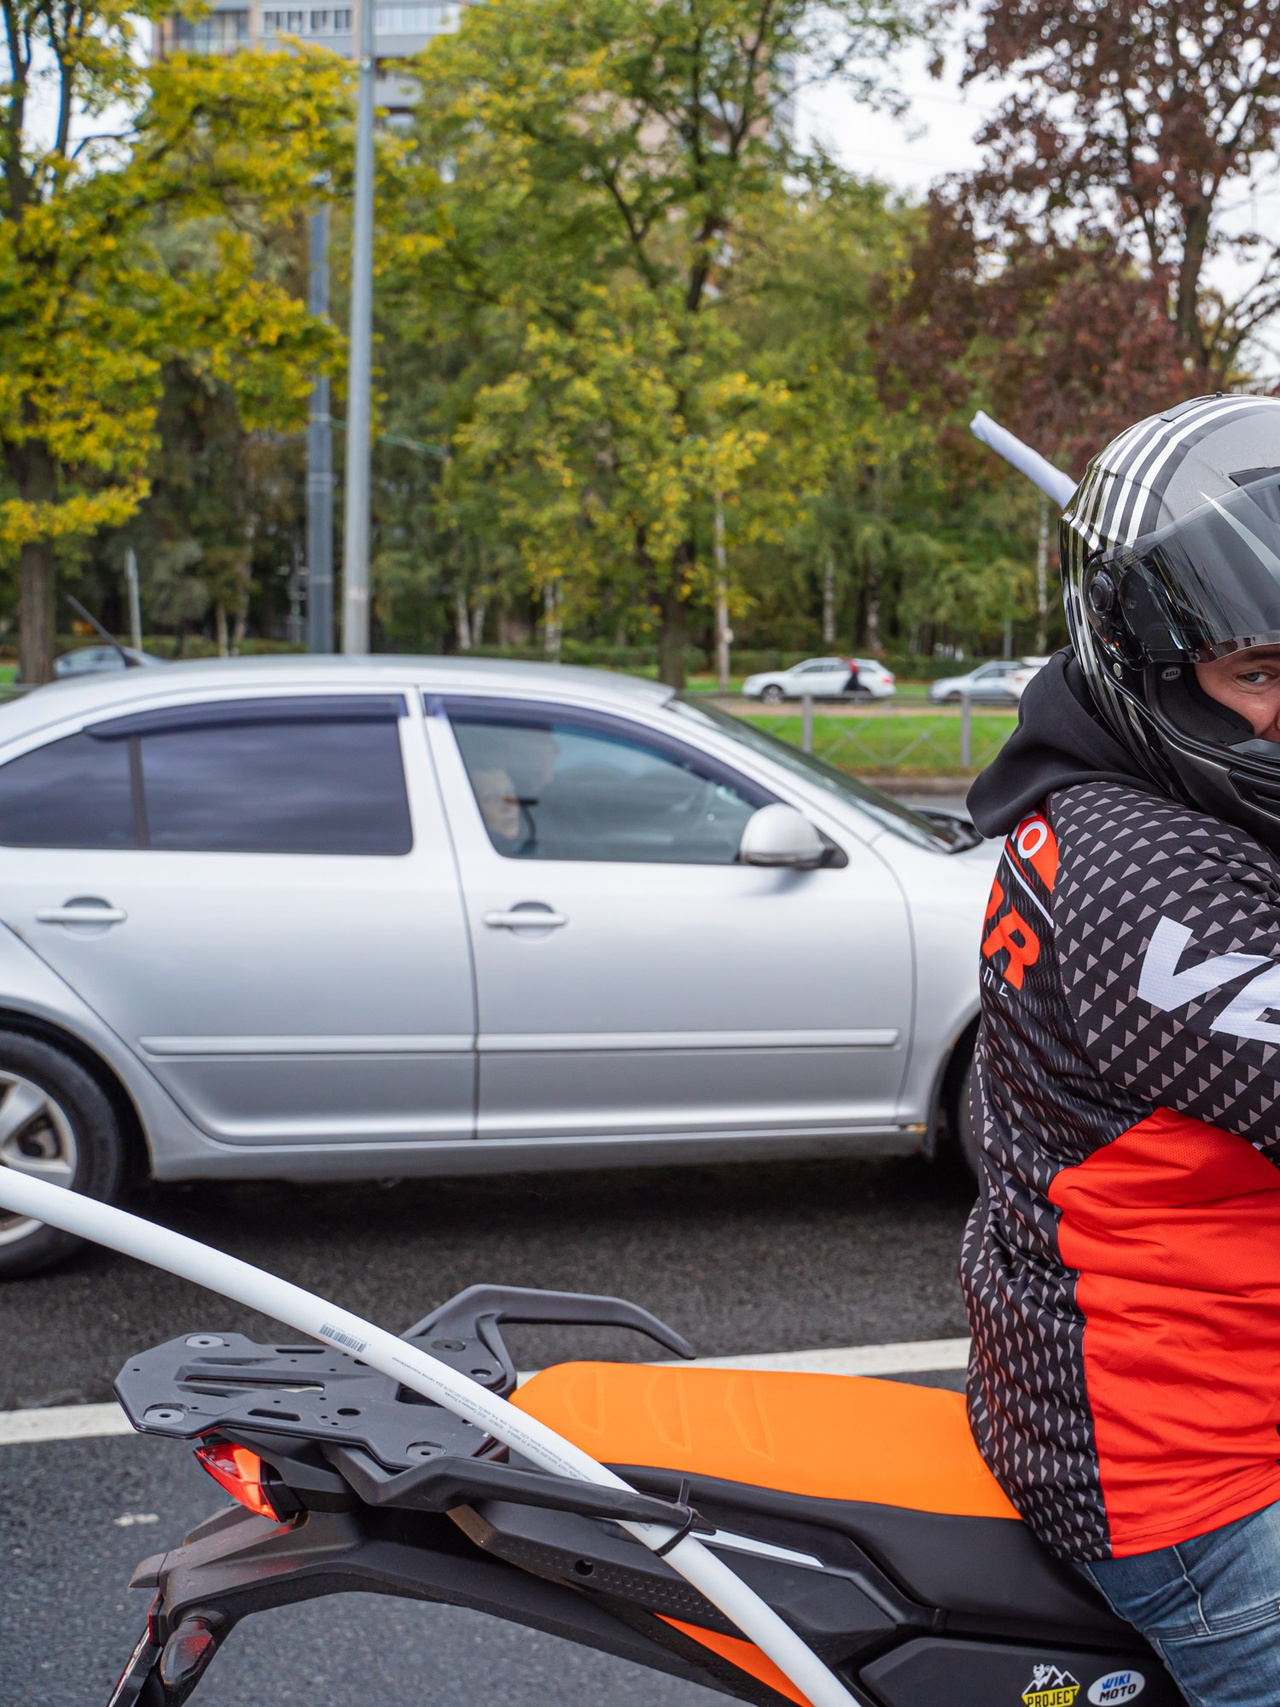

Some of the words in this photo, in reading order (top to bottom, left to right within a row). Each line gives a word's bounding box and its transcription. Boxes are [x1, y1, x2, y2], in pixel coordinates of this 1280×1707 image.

[1102, 1673, 1132, 1690] WIKI
[1027, 1687, 1078, 1707] PROJECT
[1099, 1683, 1137, 1702] MOTO
